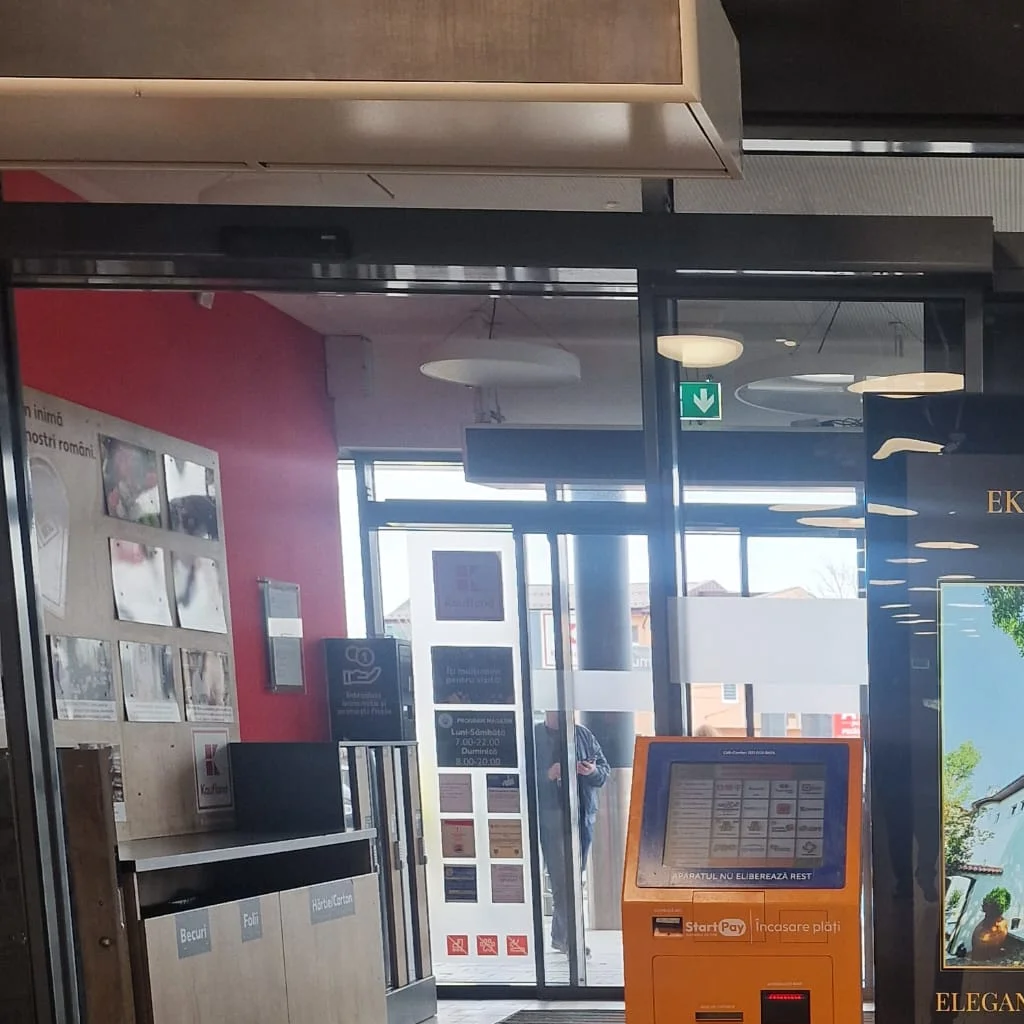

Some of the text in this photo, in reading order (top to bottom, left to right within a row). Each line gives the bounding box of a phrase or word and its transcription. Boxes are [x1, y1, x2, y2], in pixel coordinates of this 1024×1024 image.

[672, 871, 813, 880] APARATUL NU ELIBEREAZĂ REST
[243, 911, 259, 929] Folii
[756, 918, 810, 932] Încasare
[180, 923, 208, 943] Becuri
